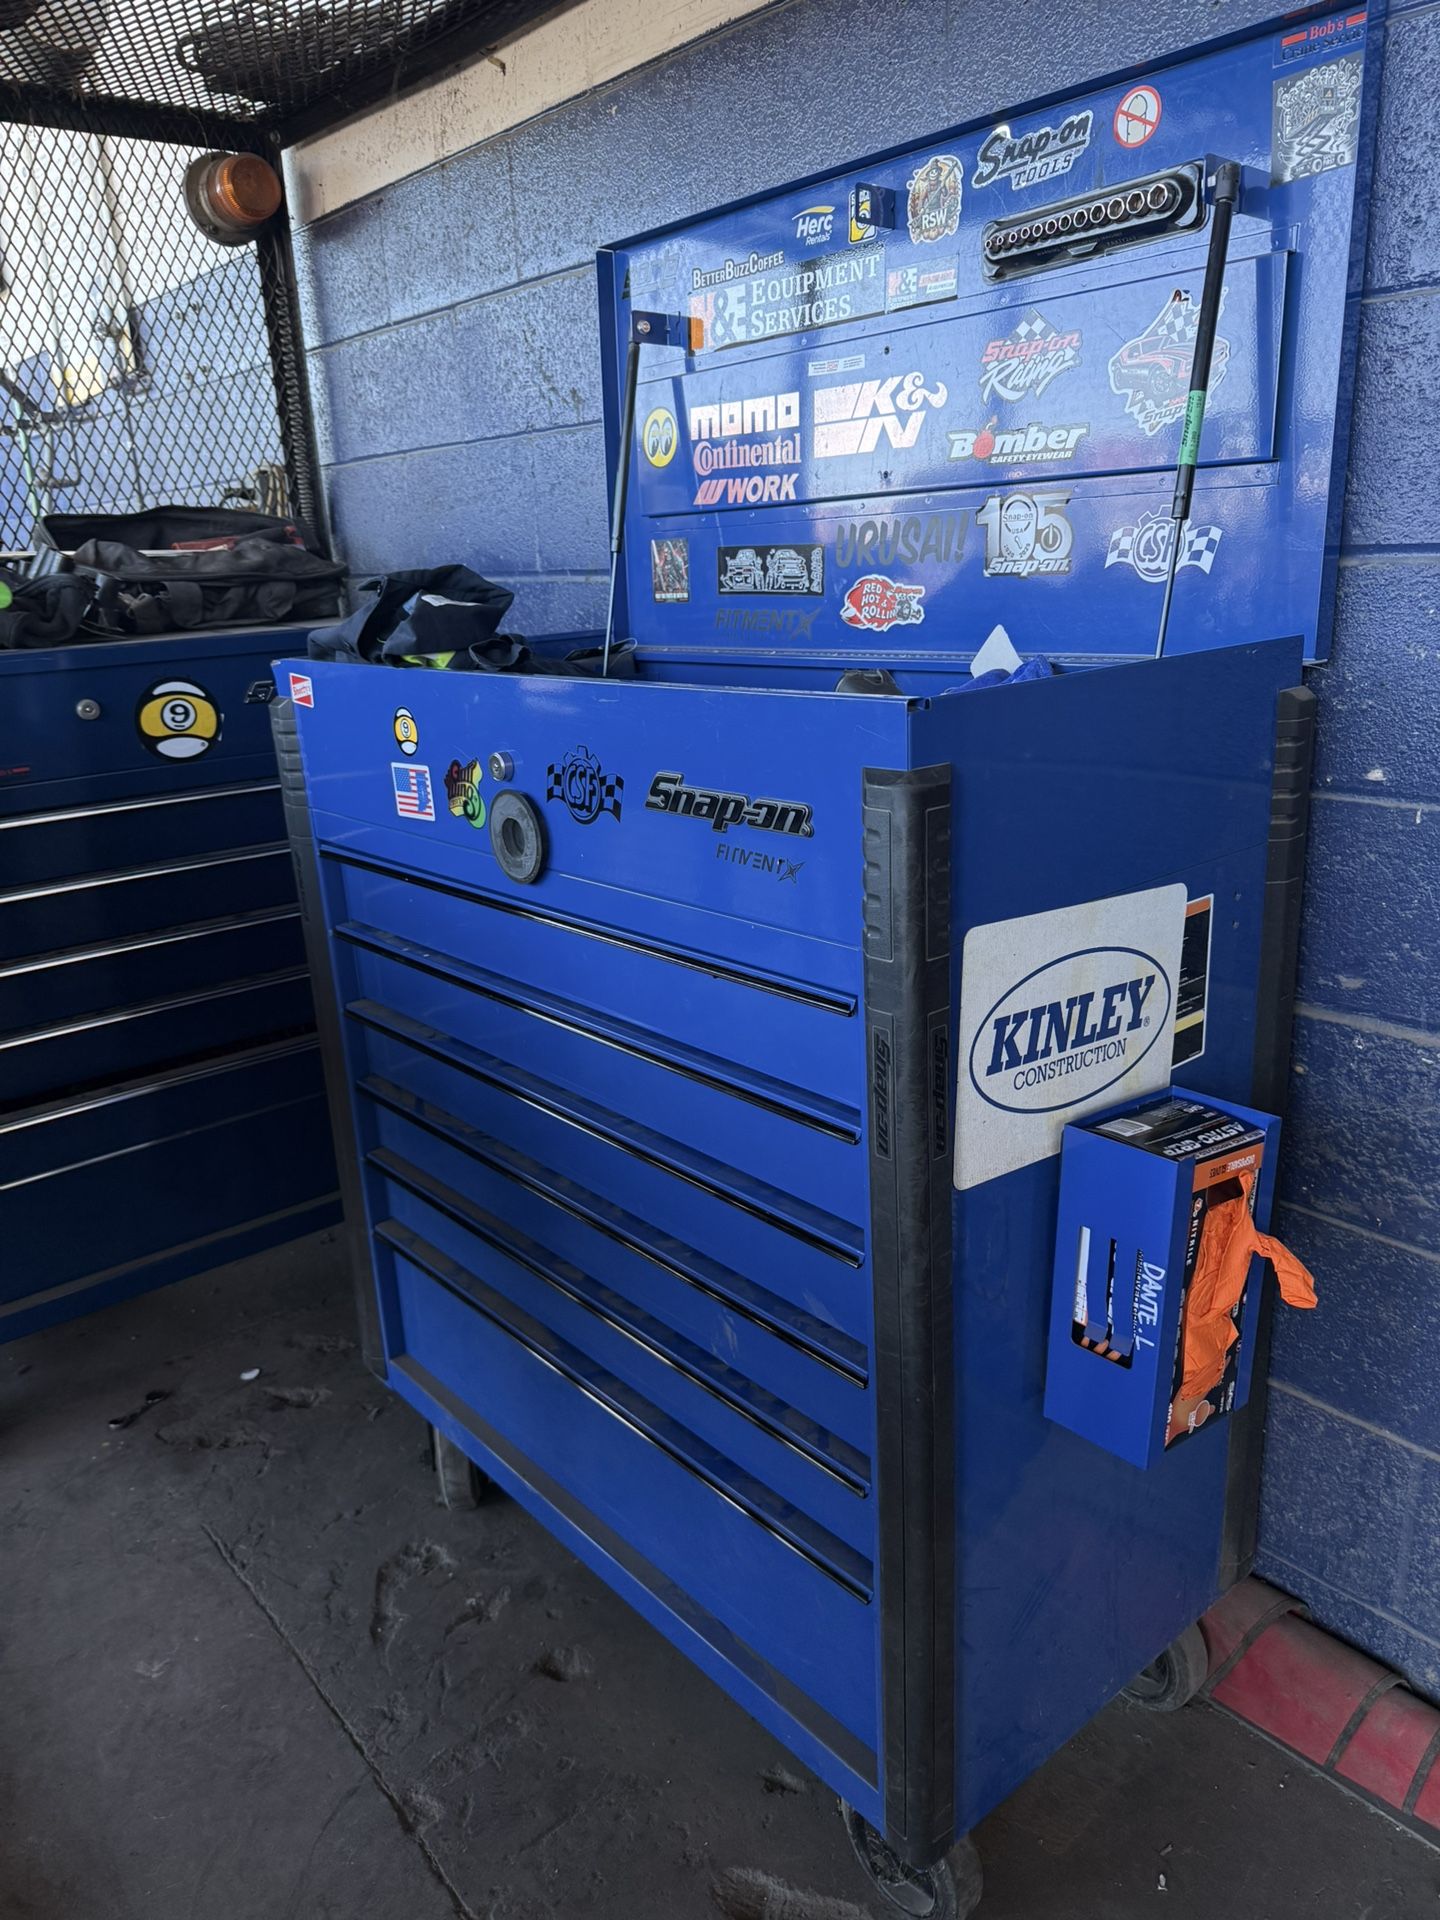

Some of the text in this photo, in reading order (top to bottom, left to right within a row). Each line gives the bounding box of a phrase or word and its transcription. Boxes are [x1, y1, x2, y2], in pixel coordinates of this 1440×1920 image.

[1309, 18, 1344, 40] Bob's
[974, 113, 1091, 185] Snap-on
[1014, 153, 1072, 187] TOOLS
[796, 214, 834, 239] Herc
[922, 209, 948, 230] RSW
[805, 232, 832, 246] Rentals
[751, 254, 881, 307] EQUIPMENT
[751, 295, 851, 337] SERVICES
[981, 330, 1082, 363] Snap-on
[979, 349, 1076, 403] Racing
[693, 432, 802, 476] Continental
[727, 473, 800, 504] WORK
[836, 511, 968, 568] URUSAI!
[987, 557, 1070, 578] Snap-on
[861, 595, 881, 607] HOT
[862, 583, 883, 594] RED
[169, 704, 190, 724] 9
[402, 721, 409, 735] 9
[567, 763, 599, 812] CSF
[645, 771, 815, 838] Snap-on
[985, 973, 1156, 1077] KINLEY
[1013, 1037, 1127, 1090] CONSTRUCTION
[1186, 1219, 1199, 1266] NITRILE
